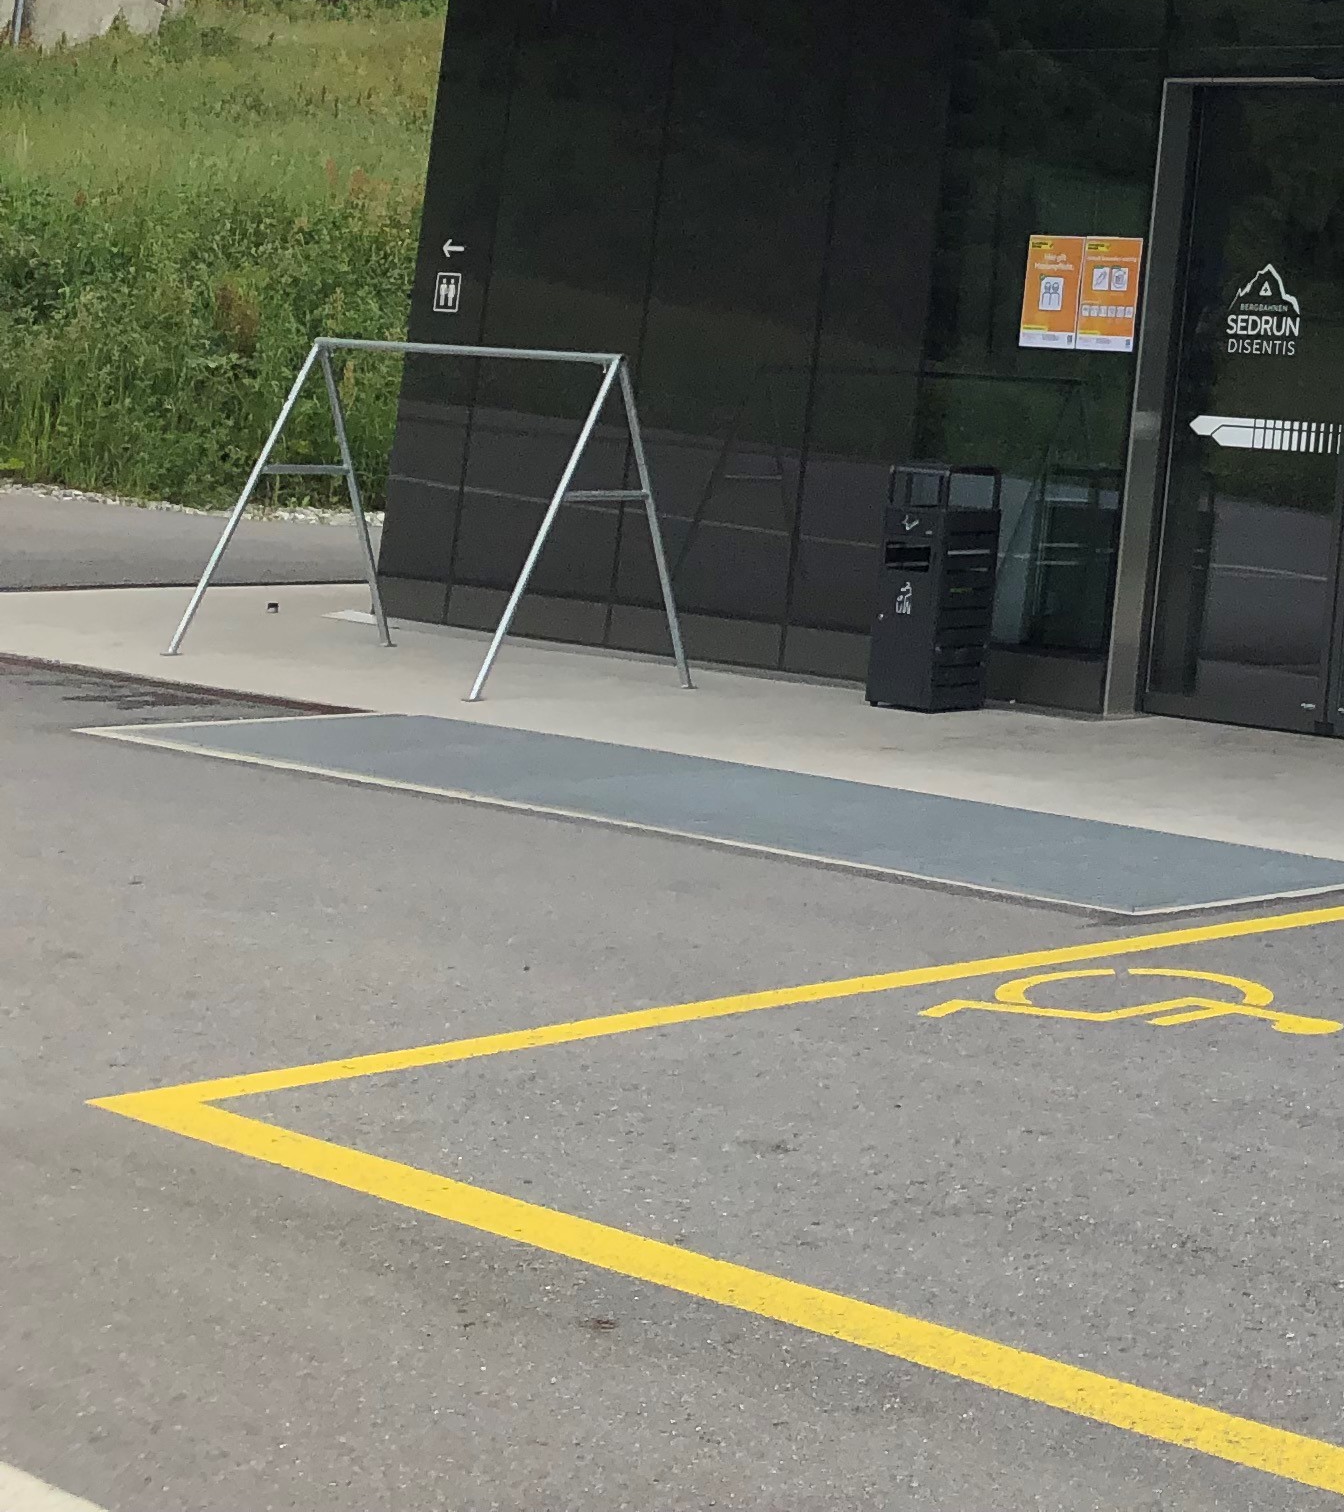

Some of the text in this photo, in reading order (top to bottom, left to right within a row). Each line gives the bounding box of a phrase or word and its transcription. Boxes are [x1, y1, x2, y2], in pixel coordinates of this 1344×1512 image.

[1240, 303, 1288, 312] BERGBAHNEN
[1226, 314, 1300, 337] SEDRUN
[1227, 338, 1296, 356] DISENTIS
